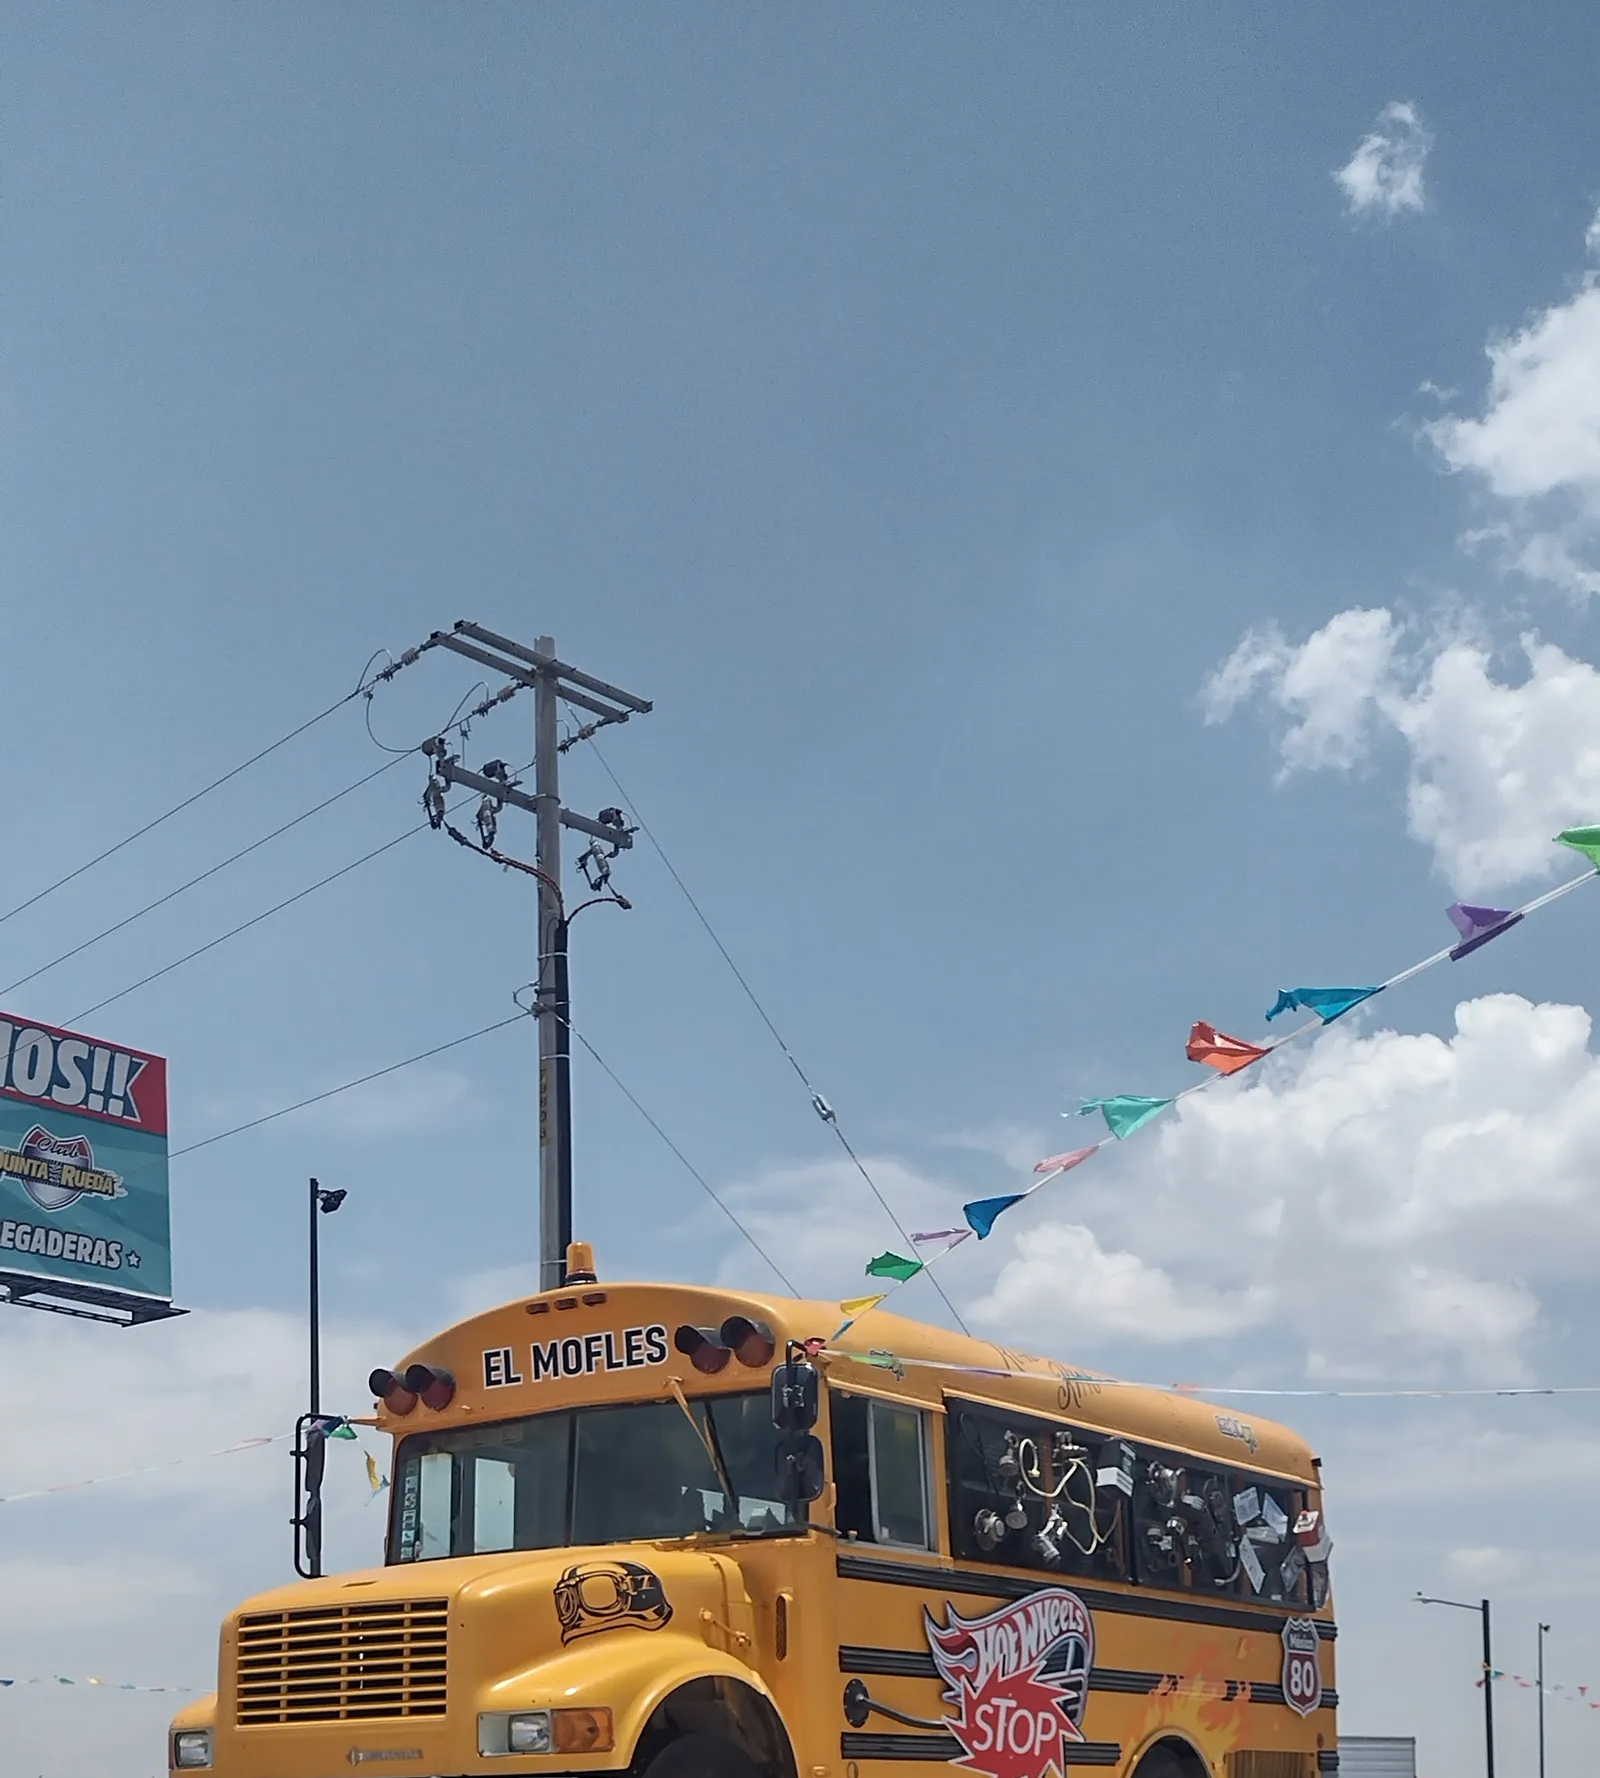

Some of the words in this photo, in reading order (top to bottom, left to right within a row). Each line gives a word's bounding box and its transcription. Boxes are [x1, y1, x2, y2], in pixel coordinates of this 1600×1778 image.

[38, 1137, 80, 1158] Club
[0, 1221, 121, 1268] EGADERAS
[483, 1348, 522, 1388] EL
[532, 1325, 667, 1381] MOFLES
[1291, 1660, 1314, 1697] 80
[972, 1697, 1057, 1757] STOP
